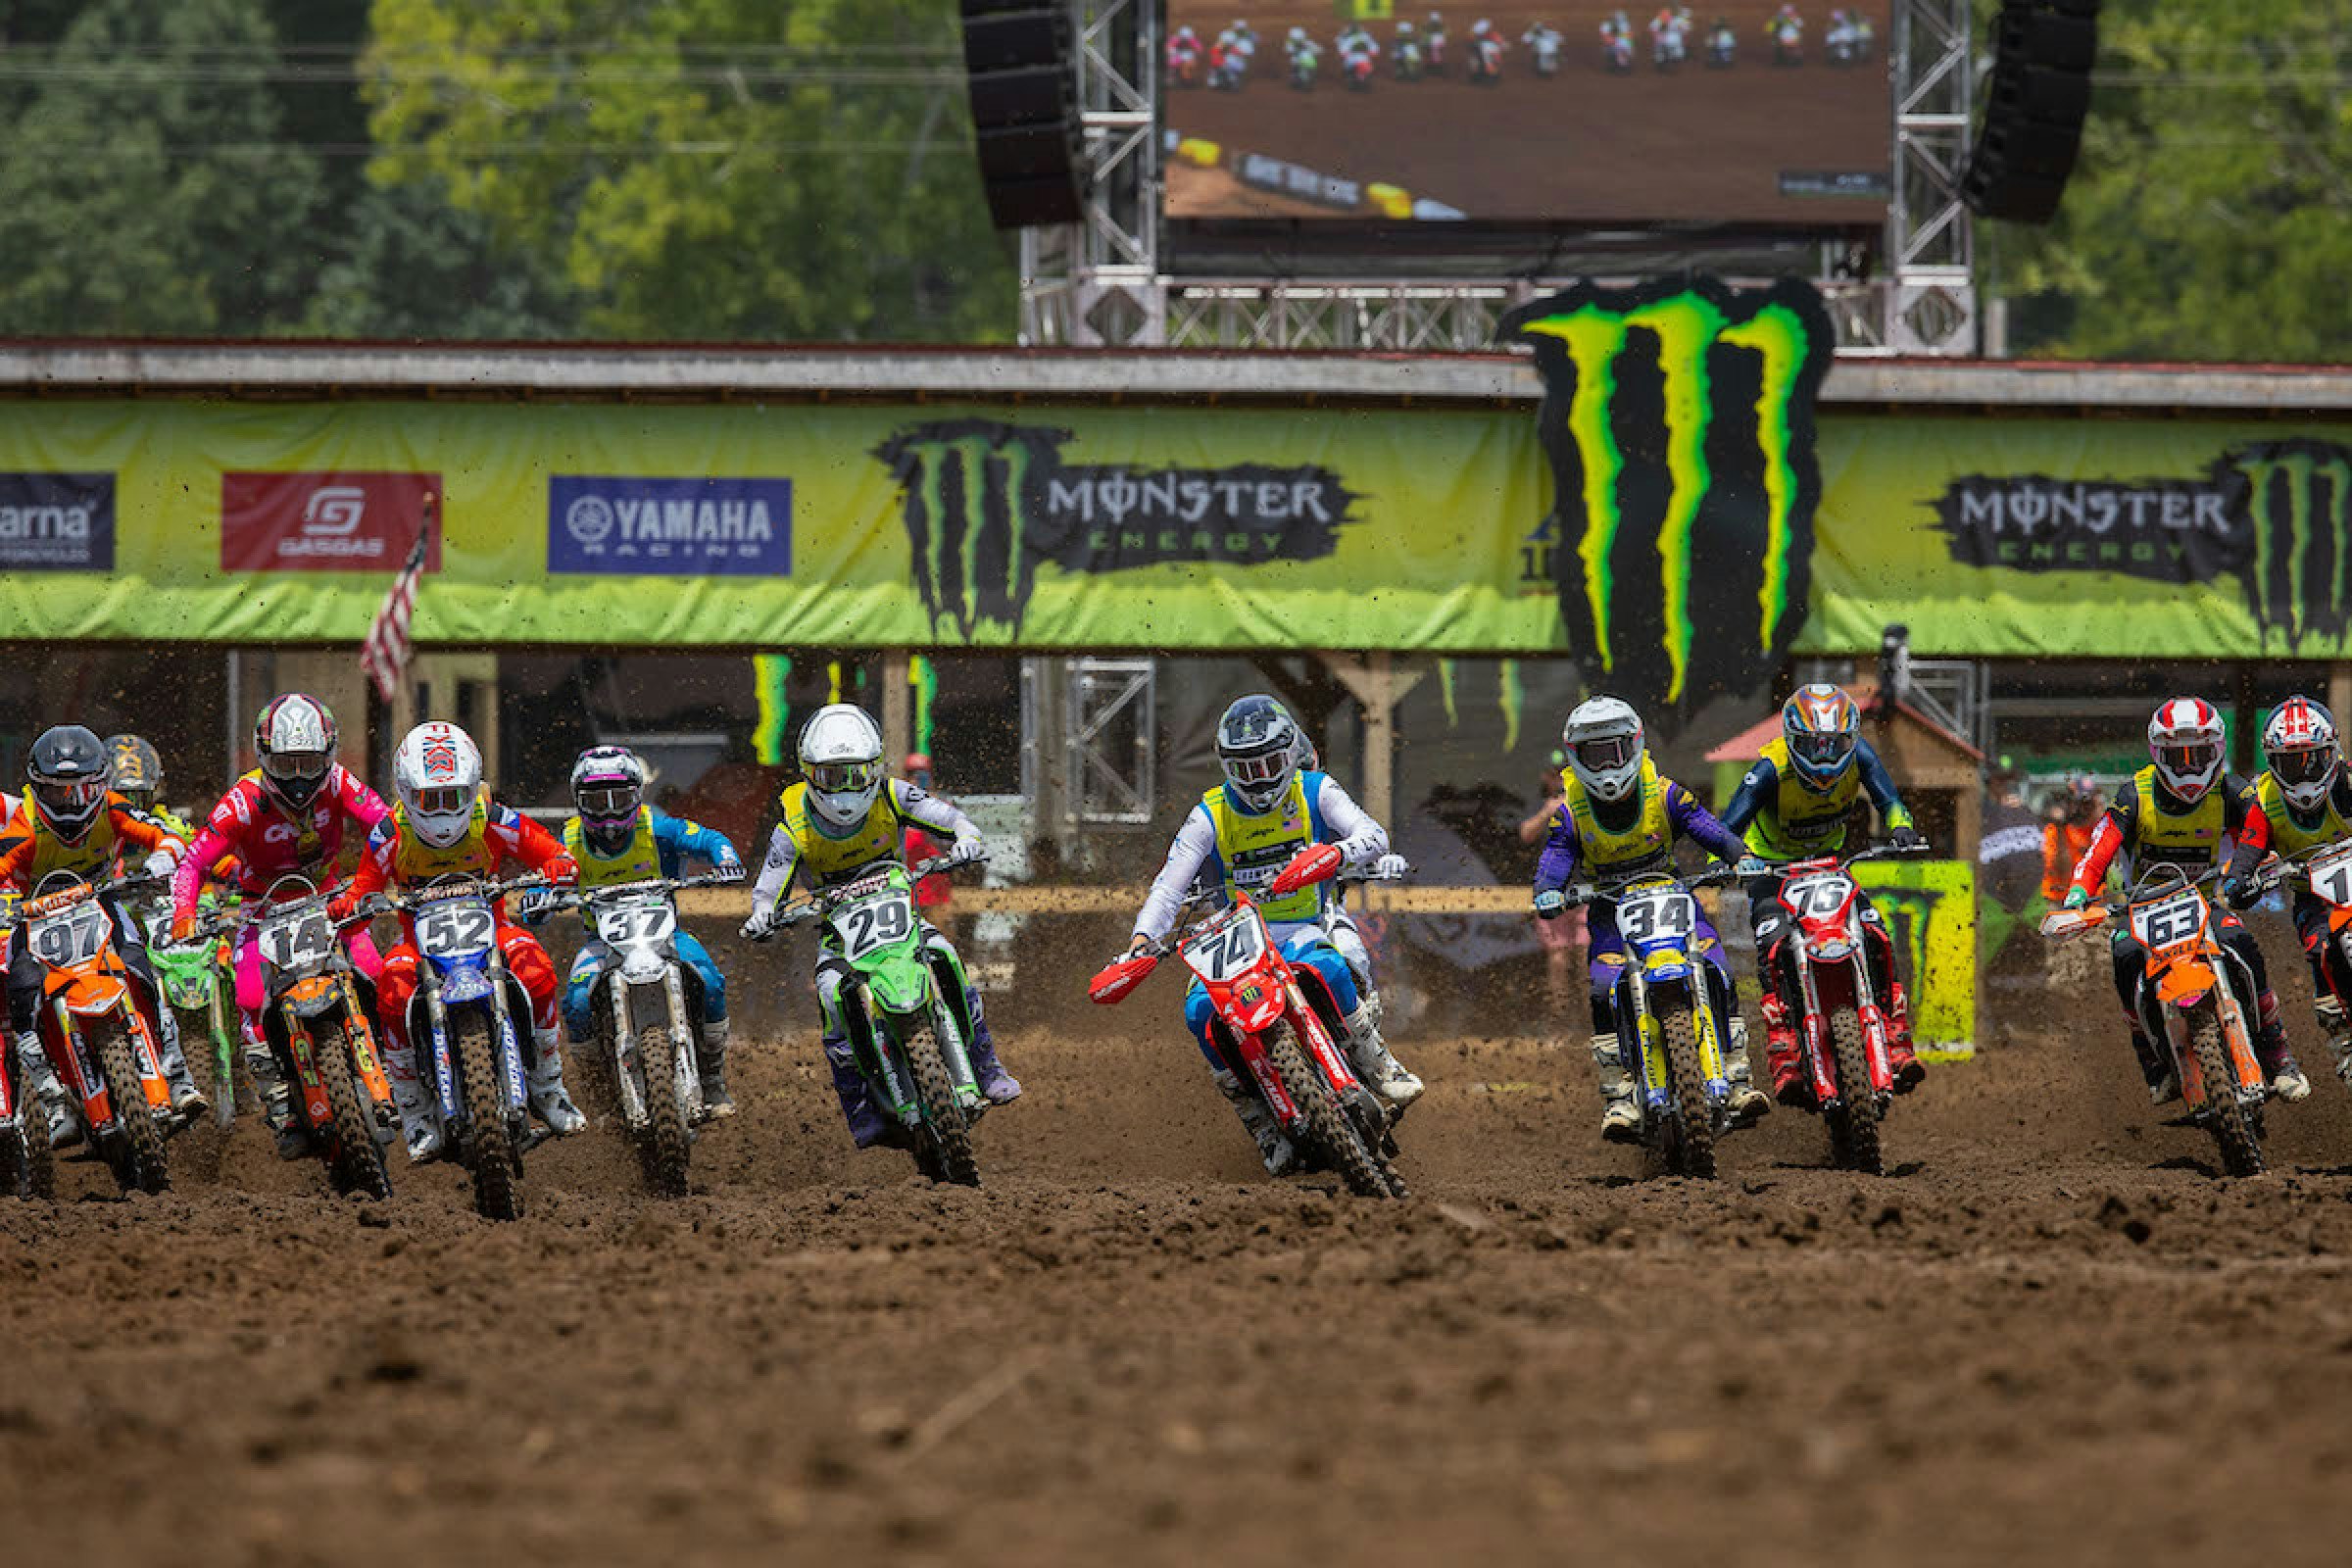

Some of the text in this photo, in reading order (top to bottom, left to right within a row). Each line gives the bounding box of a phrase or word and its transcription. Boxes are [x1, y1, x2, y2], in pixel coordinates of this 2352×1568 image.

[1048, 472, 1332, 524] MONSTER
[1961, 485, 2230, 535] MONSTER
[0, 506, 90, 539] arna
[613, 499, 772, 542] YAMAHA
[1088, 531, 1282, 550] ENERGY
[278, 538, 384, 558] GASGAS
[583, 543, 761, 557] RACING
[1997, 542, 2185, 562] ENERGY
[1791, 880, 1847, 917] 76
[2322, 867, 2350, 905] 1
[39, 912, 101, 966] 97
[270, 916, 329, 964] 14
[426, 910, 491, 954] 52
[607, 909, 668, 942] 37
[848, 901, 907, 956] 29
[1624, 897, 1690, 940] 34
[2147, 899, 2200, 948] 63
[1200, 918, 1255, 979] 74
